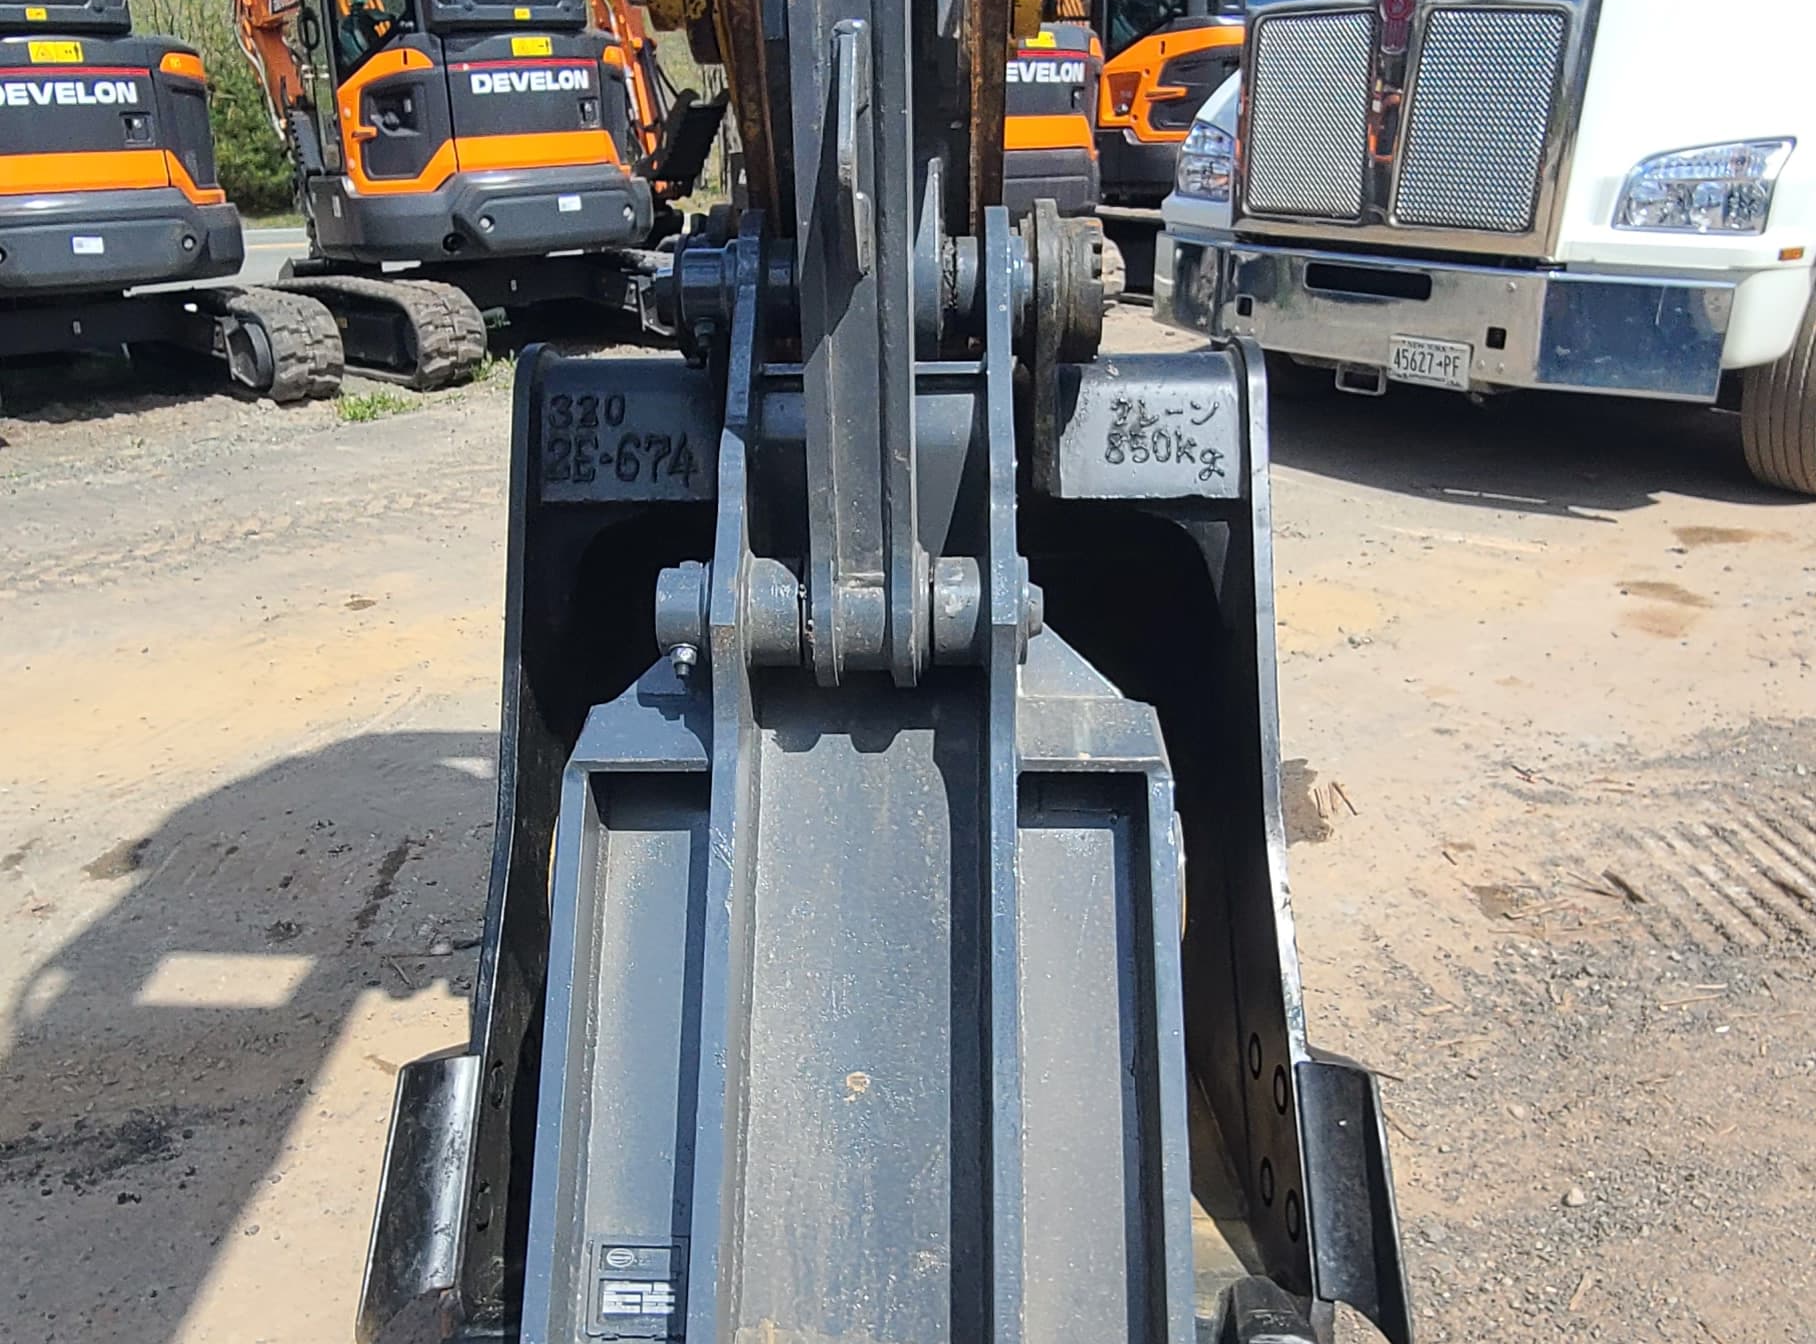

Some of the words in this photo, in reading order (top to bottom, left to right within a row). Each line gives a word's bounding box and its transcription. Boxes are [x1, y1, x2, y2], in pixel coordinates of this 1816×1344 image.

[471, 70, 589, 94] DEVELON
[1006, 62, 1085, 83] EVELON
[0, 82, 138, 105] EVELON
[549, 394, 625, 427] 320
[1105, 428, 1225, 481] 850kg
